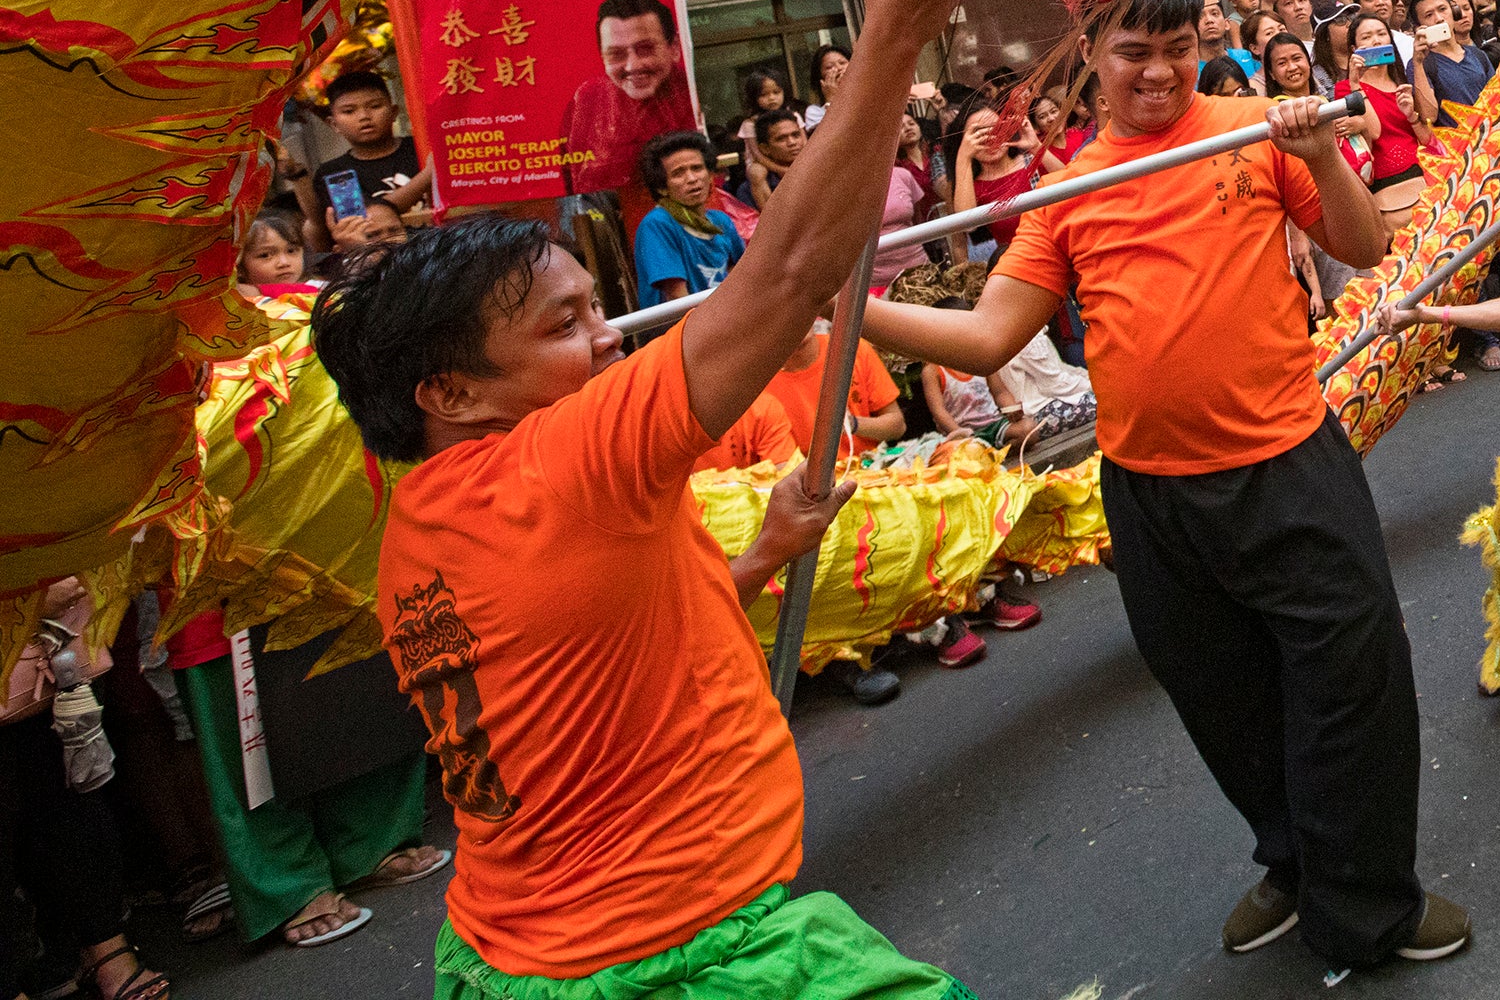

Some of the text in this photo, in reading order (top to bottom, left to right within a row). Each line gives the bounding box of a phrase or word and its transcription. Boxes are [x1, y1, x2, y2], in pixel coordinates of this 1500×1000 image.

[439, 3, 536, 48] 恭喜
[439, 56, 537, 95] 發財
[441, 114, 525, 129] GREETINGS FROM
[445, 130, 505, 146] MAYOR
[448, 145, 507, 161] JOSEPH
[449, 150, 596, 176] EJERCITO ESTRADA
[451, 170, 560, 188] Mayor, City of Manila
